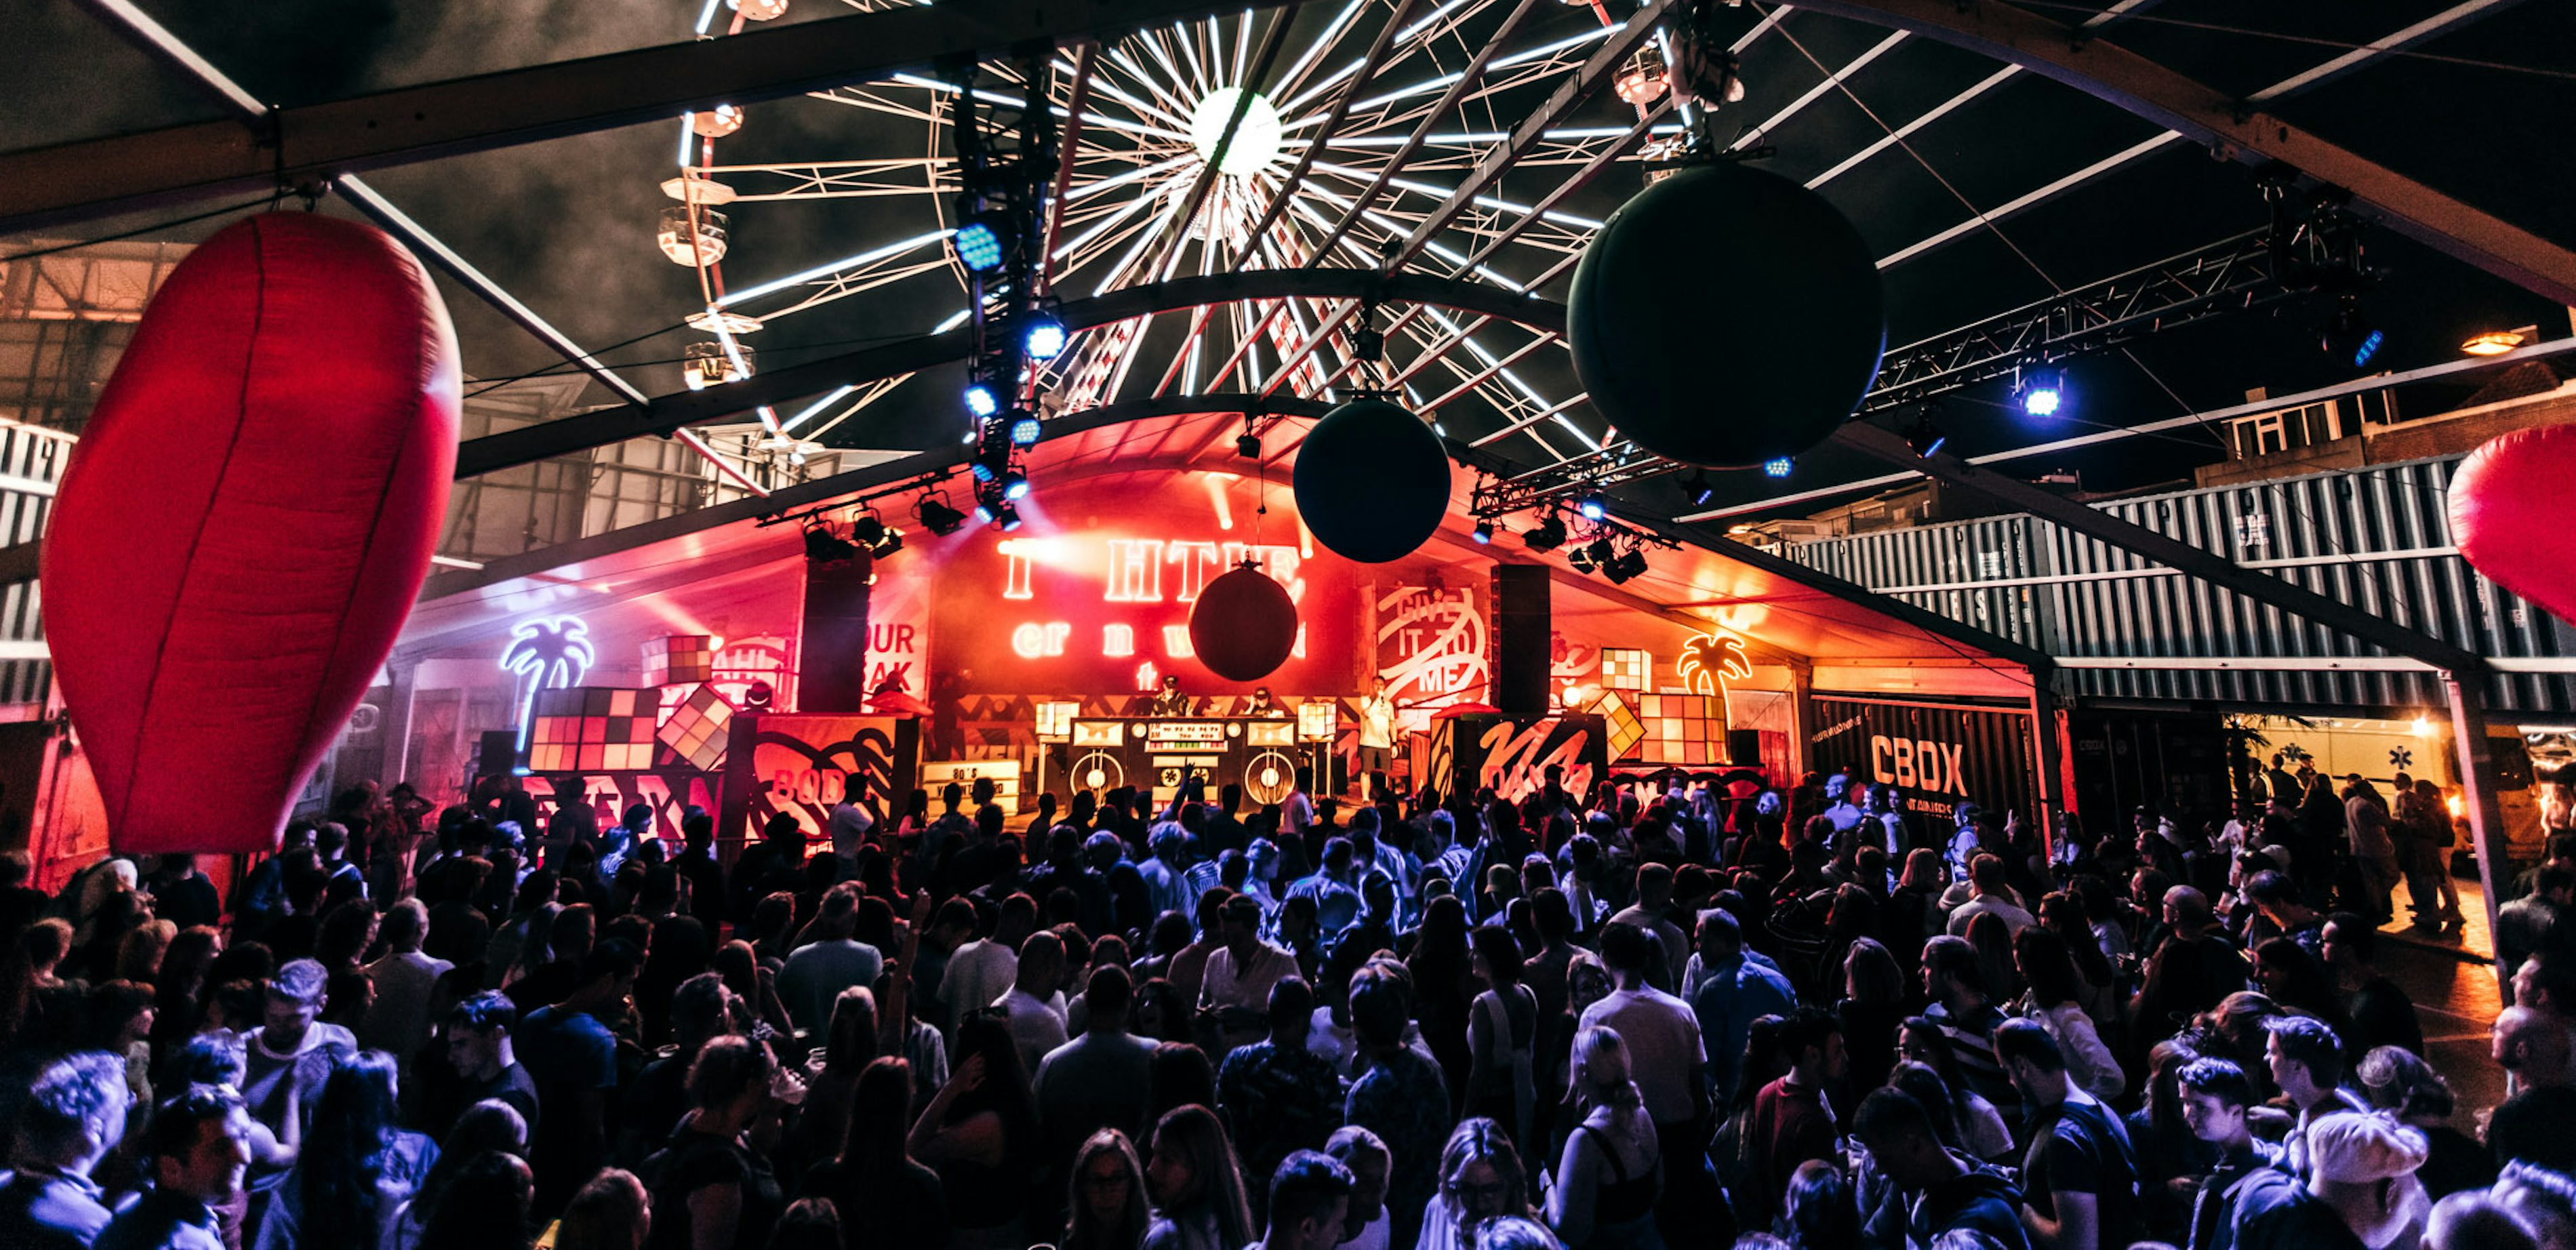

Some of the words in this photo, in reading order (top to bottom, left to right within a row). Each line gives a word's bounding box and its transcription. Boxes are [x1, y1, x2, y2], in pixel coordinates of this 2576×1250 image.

[1396, 594, 1459, 622] GIVE
[868, 624, 914, 653] UR
[1398, 628, 1424, 657] IT
[1436, 628, 1470, 656] TO
[866, 662, 912, 691] AK
[1419, 665, 1460, 693] ME
[952, 767, 978, 780] 80'S
[1871, 734, 1969, 797] CBOX
[771, 768, 847, 805] BOD
